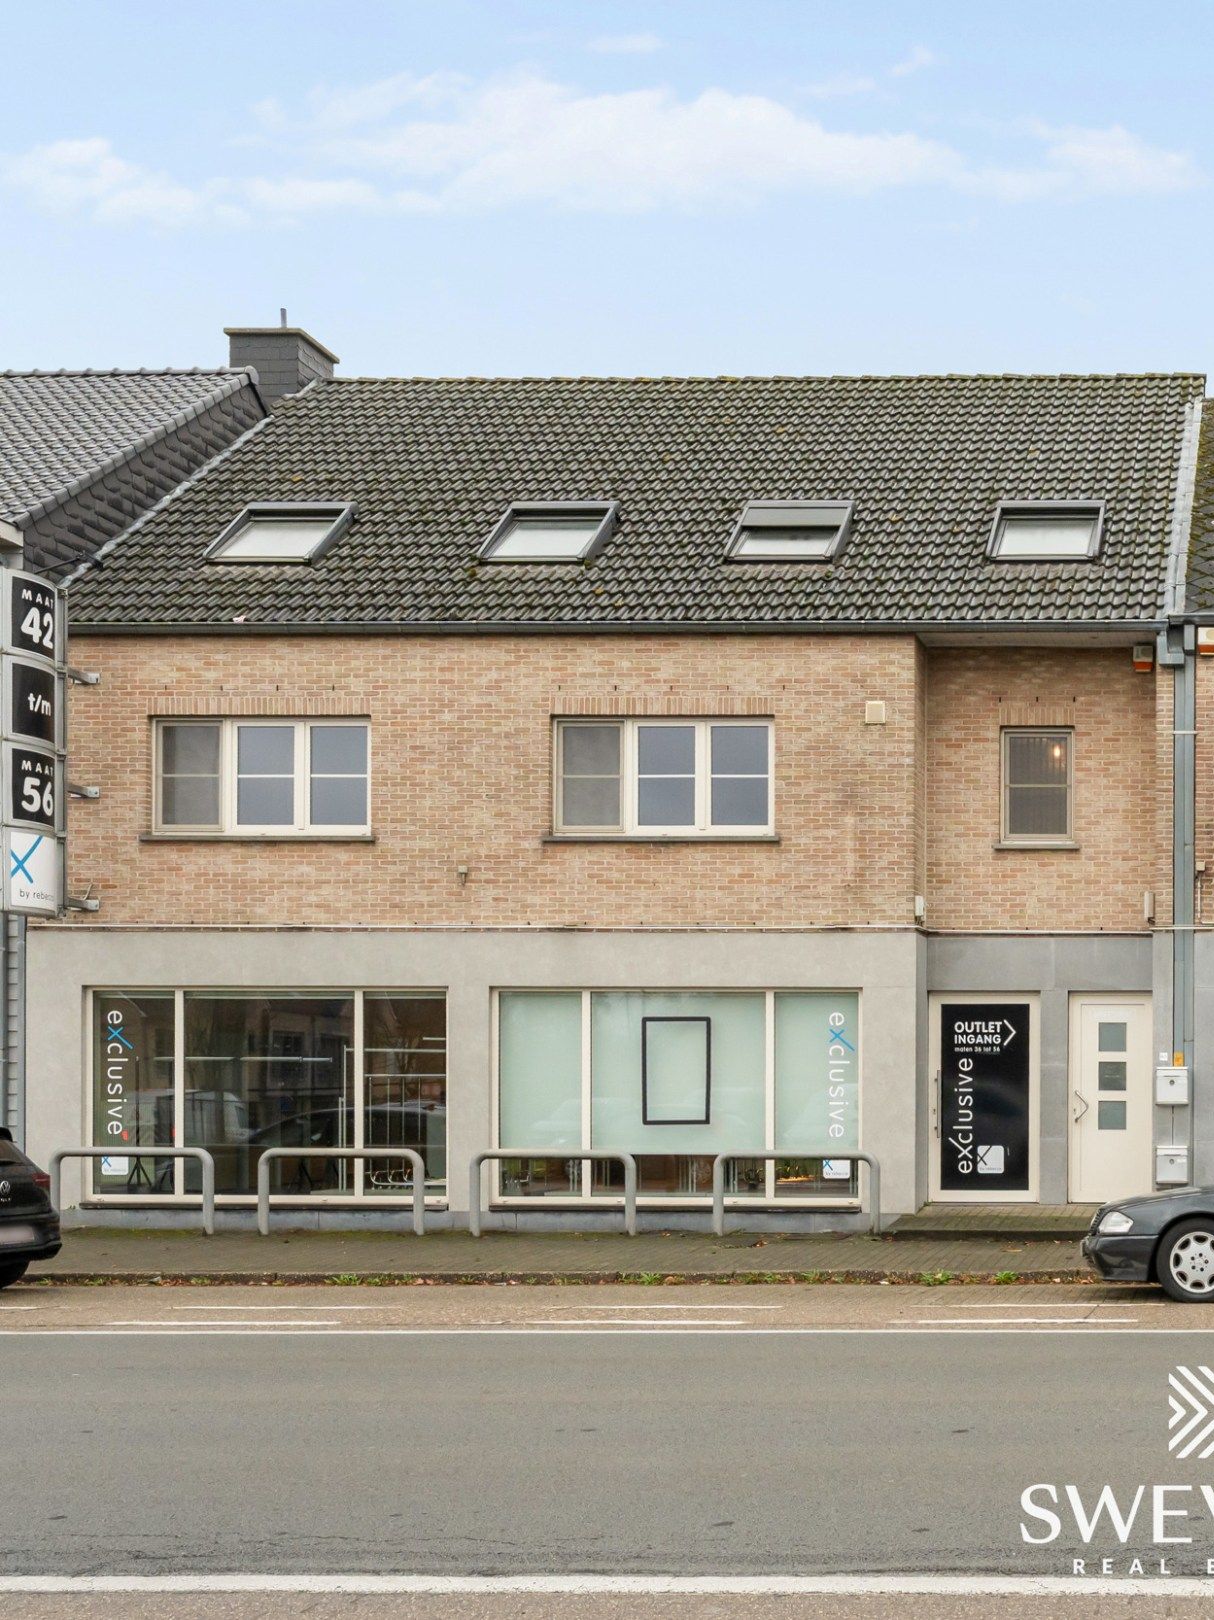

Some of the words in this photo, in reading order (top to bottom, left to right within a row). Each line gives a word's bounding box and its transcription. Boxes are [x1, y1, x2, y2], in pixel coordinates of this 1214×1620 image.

[21, 589, 54, 609] MAAT
[21, 607, 54, 649] 42
[28, 692, 51, 716] t/m
[21, 760, 54, 777] MAAT
[21, 777, 54, 816] 56
[19, 888, 30, 899] by
[954, 1021, 1003, 1033] OUTLET
[954, 1034, 1002, 1044] INGANG
[107, 1010, 134, 1135] exclusive
[828, 1012, 855, 1137] exclusive
[948, 1058, 973, 1173] exclusive
